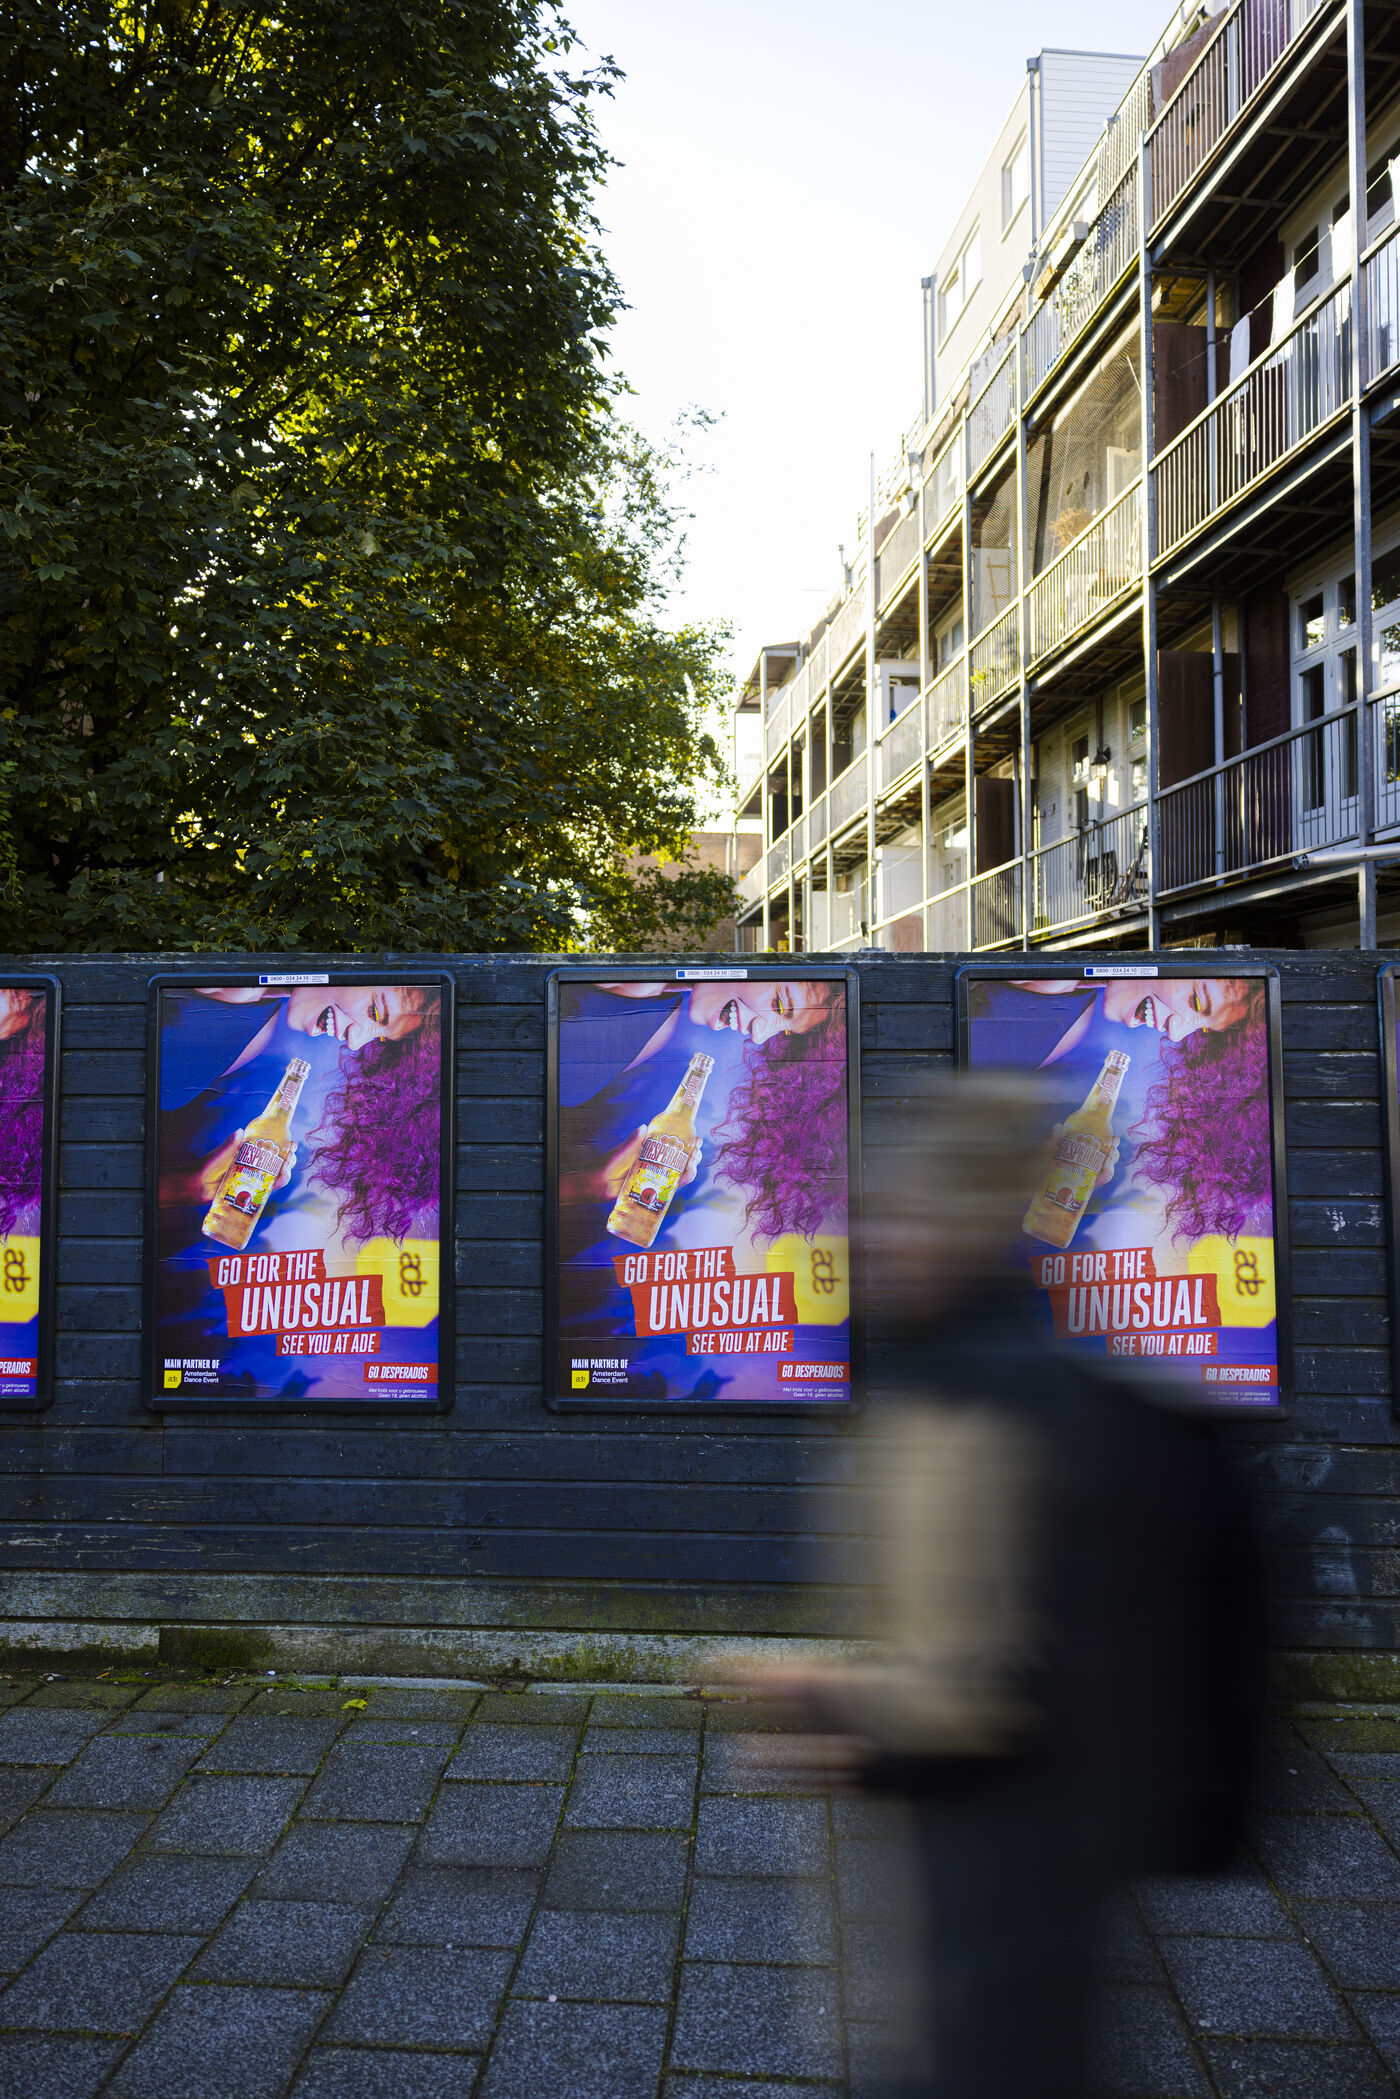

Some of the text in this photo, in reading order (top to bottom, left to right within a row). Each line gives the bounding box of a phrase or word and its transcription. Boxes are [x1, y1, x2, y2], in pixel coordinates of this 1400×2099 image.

[217, 1252, 318, 1286] GO FOR THE
[624, 1249, 727, 1284] GO FOR THE
[1041, 1250, 1146, 1286] GO FOR THE
[240, 1279, 372, 1332] UNUSUAL
[649, 1276, 784, 1331] UNUSUAL
[1068, 1278, 1208, 1333] UNUSUAL
[281, 1334, 376, 1354] SEE YOU AT ADE
[692, 1332, 789, 1354] SEE YOU AT ADE
[1112, 1334, 1212, 1356] SEE YOU AT ADE
[164, 1358, 220, 1369] MAIN PARTNER OF
[368, 1366, 428, 1380] GO DESPERADOS
[572, 1358, 629, 1369] MAIN PARTNER OF
[782, 1365, 844, 1378] GO DESPERADOS
[1206, 1368, 1270, 1382] GO DESPERADOS
